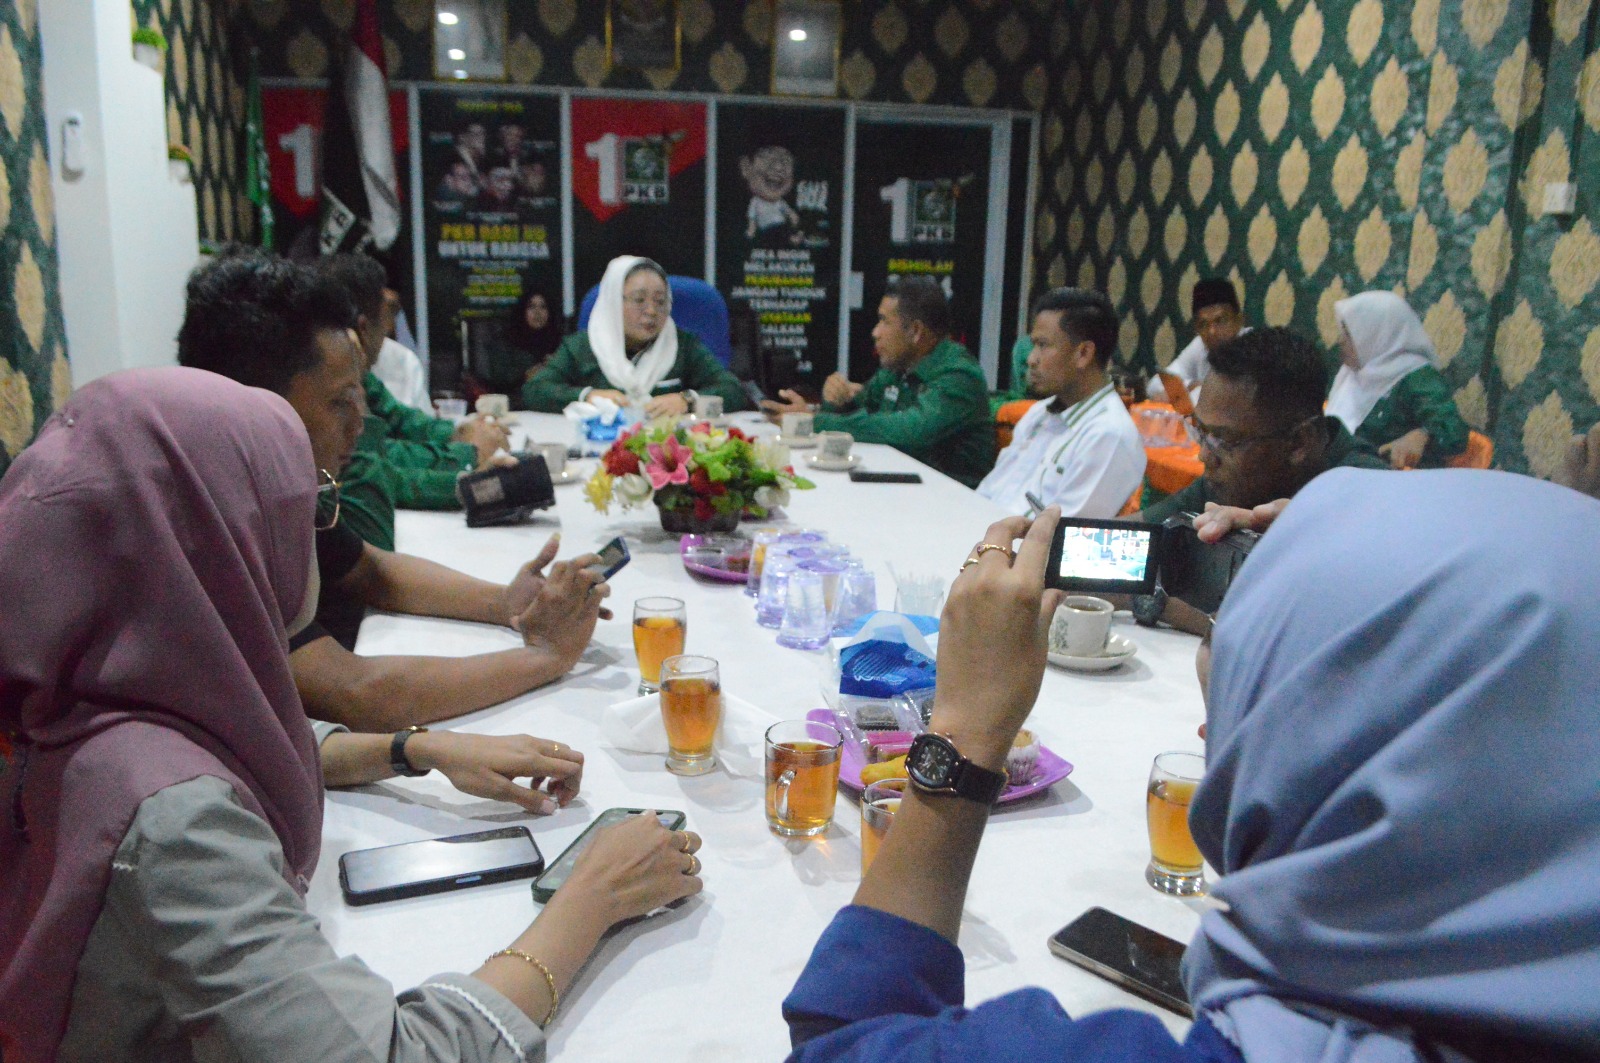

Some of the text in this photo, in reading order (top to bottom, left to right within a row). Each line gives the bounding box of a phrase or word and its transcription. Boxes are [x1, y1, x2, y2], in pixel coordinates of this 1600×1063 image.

[279, 124, 315, 197] 1
[584, 132, 617, 206] 1
[623, 184, 666, 200] PKB
[880, 176, 908, 243] 1
[914, 225, 955, 240] PKB
